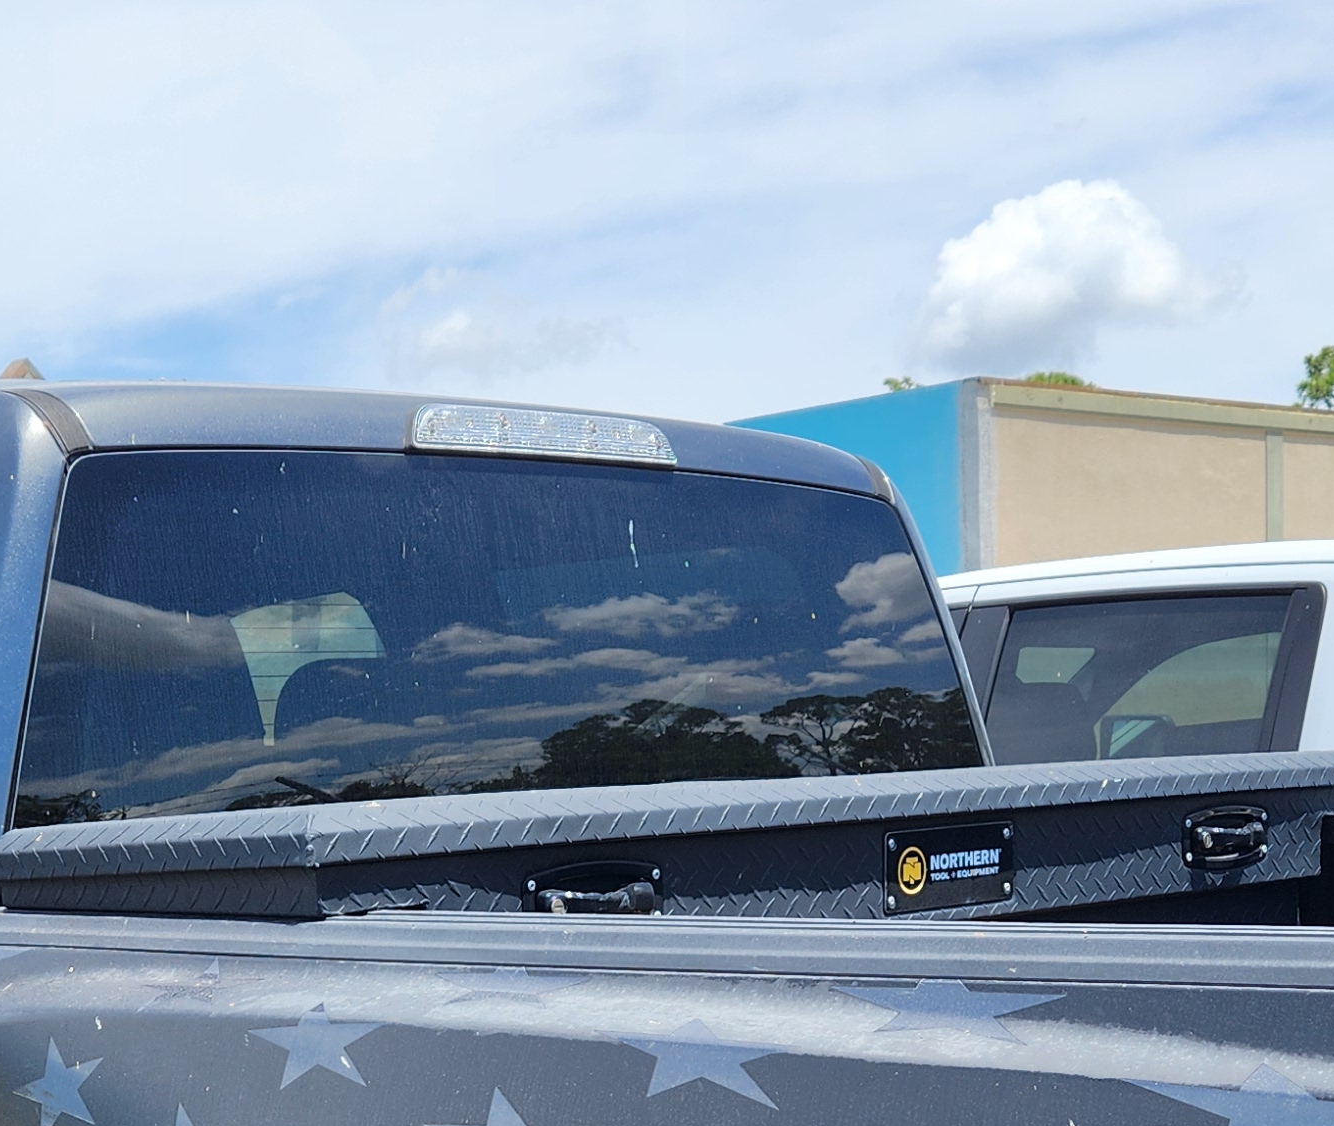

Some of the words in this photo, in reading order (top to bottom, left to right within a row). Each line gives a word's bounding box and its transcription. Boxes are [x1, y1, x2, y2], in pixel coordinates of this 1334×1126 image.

[929, 848, 1000, 871] NORTHERN
[930, 872, 950, 882] TOOL
[957, 866, 1000, 879] EQUIPMENT
